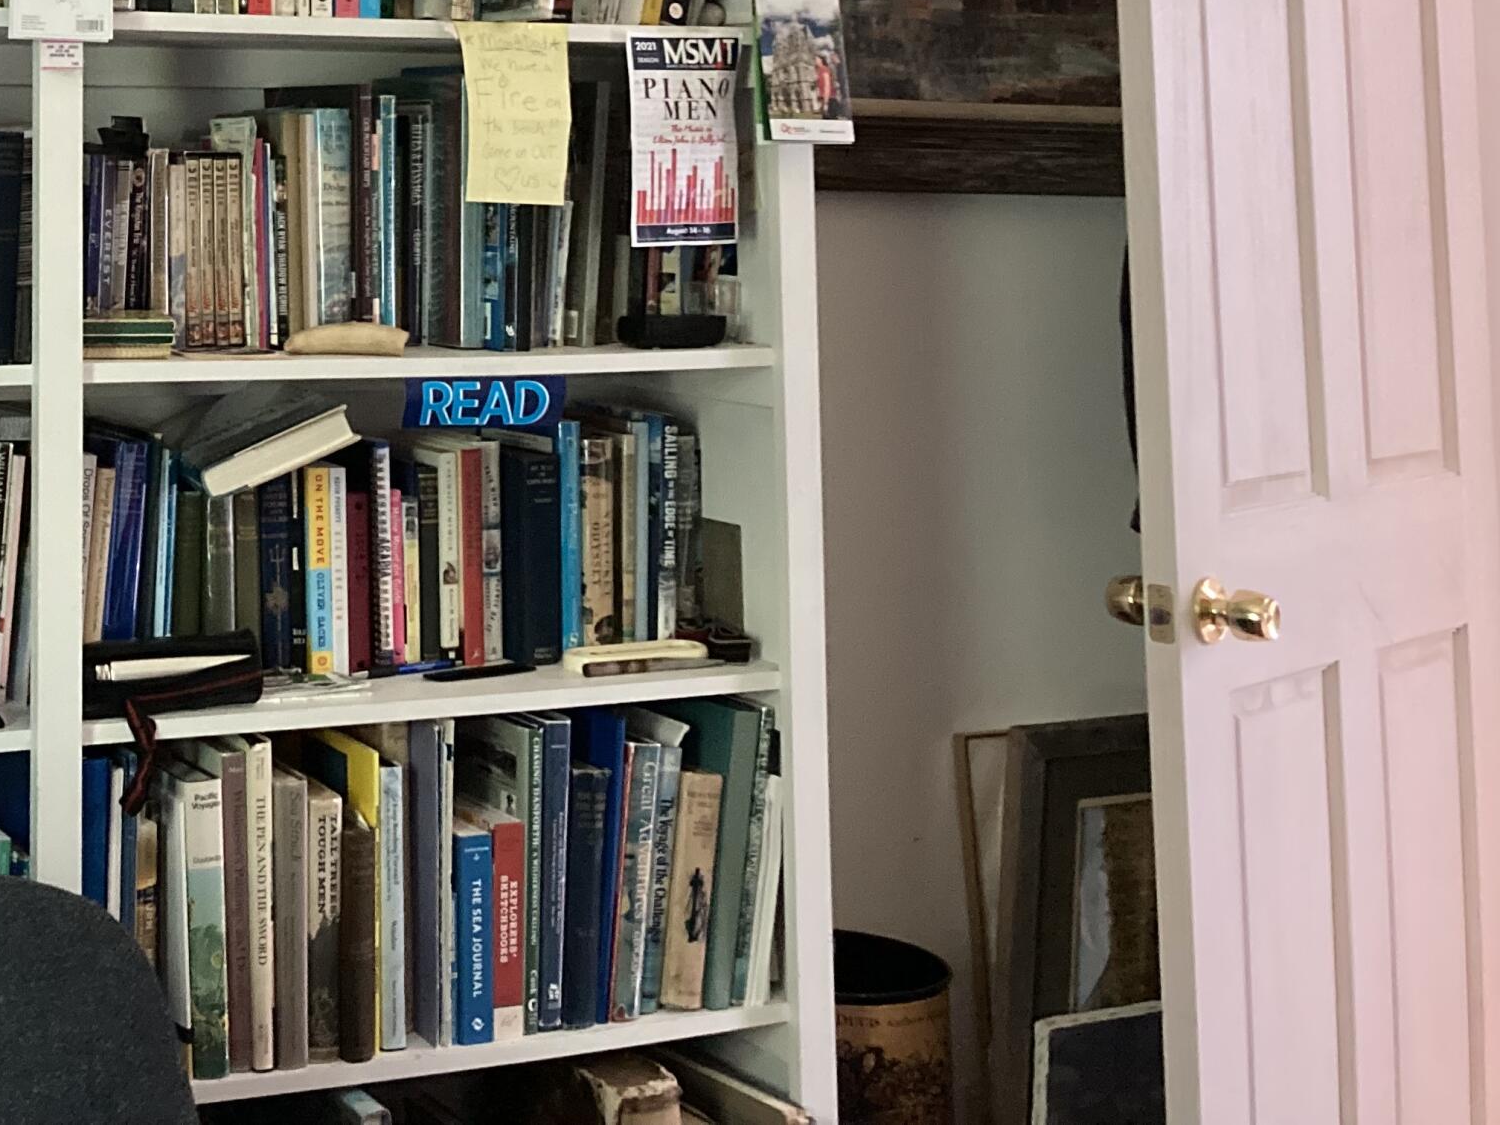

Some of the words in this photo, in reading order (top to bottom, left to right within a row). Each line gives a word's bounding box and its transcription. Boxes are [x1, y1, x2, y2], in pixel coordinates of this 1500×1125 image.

[635, 41, 656, 51] 2021
[663, 38, 735, 65] MSMT
[644, 78, 729, 99] PIANO
[663, 100, 717, 120] MEN
[277, 211, 285, 228] JACK
[102, 209, 112, 283] EVEREST
[277, 252, 286, 284] SHADOW
[419, 379, 550, 427] READ
[664, 425, 677, 478] SAILING
[82, 468, 93, 501] Drops
[315, 474, 323, 491] ON
[81, 504, 91, 518] Of
[315, 497, 323, 521] THE
[664, 500, 676, 529] EDGE
[315, 527, 324, 564] MOVE
[663, 539, 675, 567] TIME
[316, 572, 325, 611] OLIVER
[317, 616, 325, 648] SACKS
[532, 737, 540, 784] CHASING
[194, 792, 219, 802] Pacific
[640, 760, 655, 811] Great
[254, 796, 266, 823] THE
[659, 796, 674, 817] The
[255, 826, 266, 852] PEN
[317, 815, 326, 873] TOUGH
[329, 813, 337, 856] TALL
[653, 817, 672, 855] Voyage
[256, 852, 267, 884] AND
[633, 818, 652, 920] Adventures
[654, 867, 668, 885] the
[256, 887, 268, 913] THE
[317, 877, 326, 914] MEN
[471, 878, 481, 904] THE
[471, 908, 481, 933] SEA
[499, 875, 508, 963] SKETCHBOOKS
[508, 880, 518, 957] EXPLORERS'
[257, 918, 269, 966] SWORD
[471, 936, 482, 997] JOURNAL
